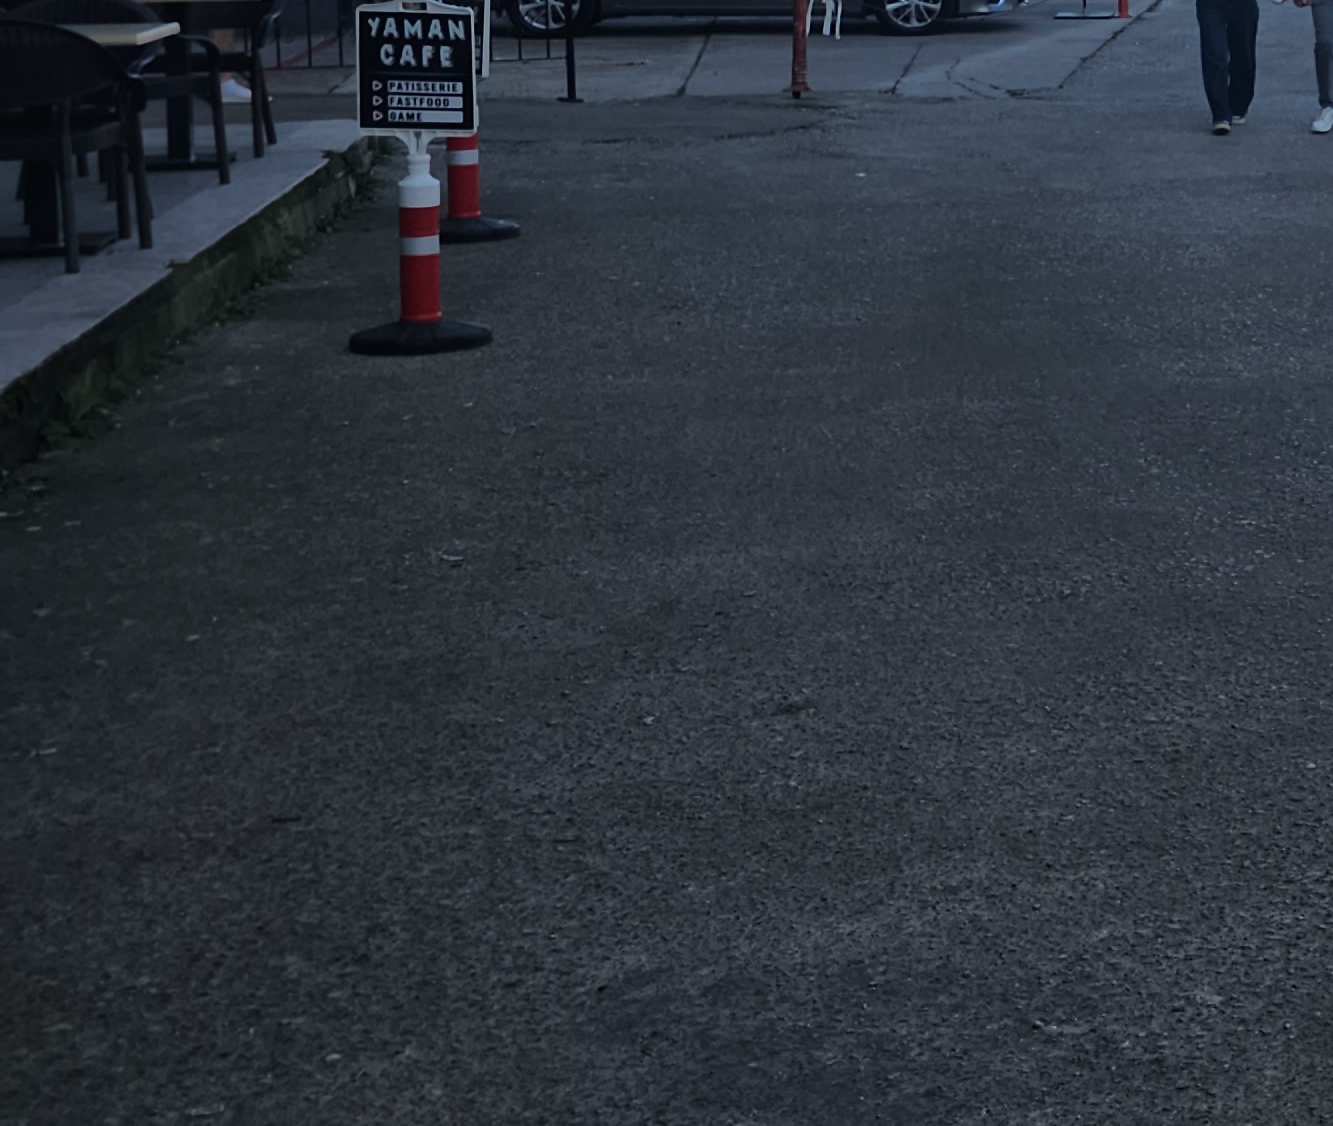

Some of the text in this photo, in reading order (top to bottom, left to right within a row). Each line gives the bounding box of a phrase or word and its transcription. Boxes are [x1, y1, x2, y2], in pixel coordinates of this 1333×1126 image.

[368, 17, 465, 40] YAMAN
[380, 44, 453, 67] CAFE
[389, 81, 458, 92] PATISSERIE
[389, 96, 450, 107] FASTFOOD
